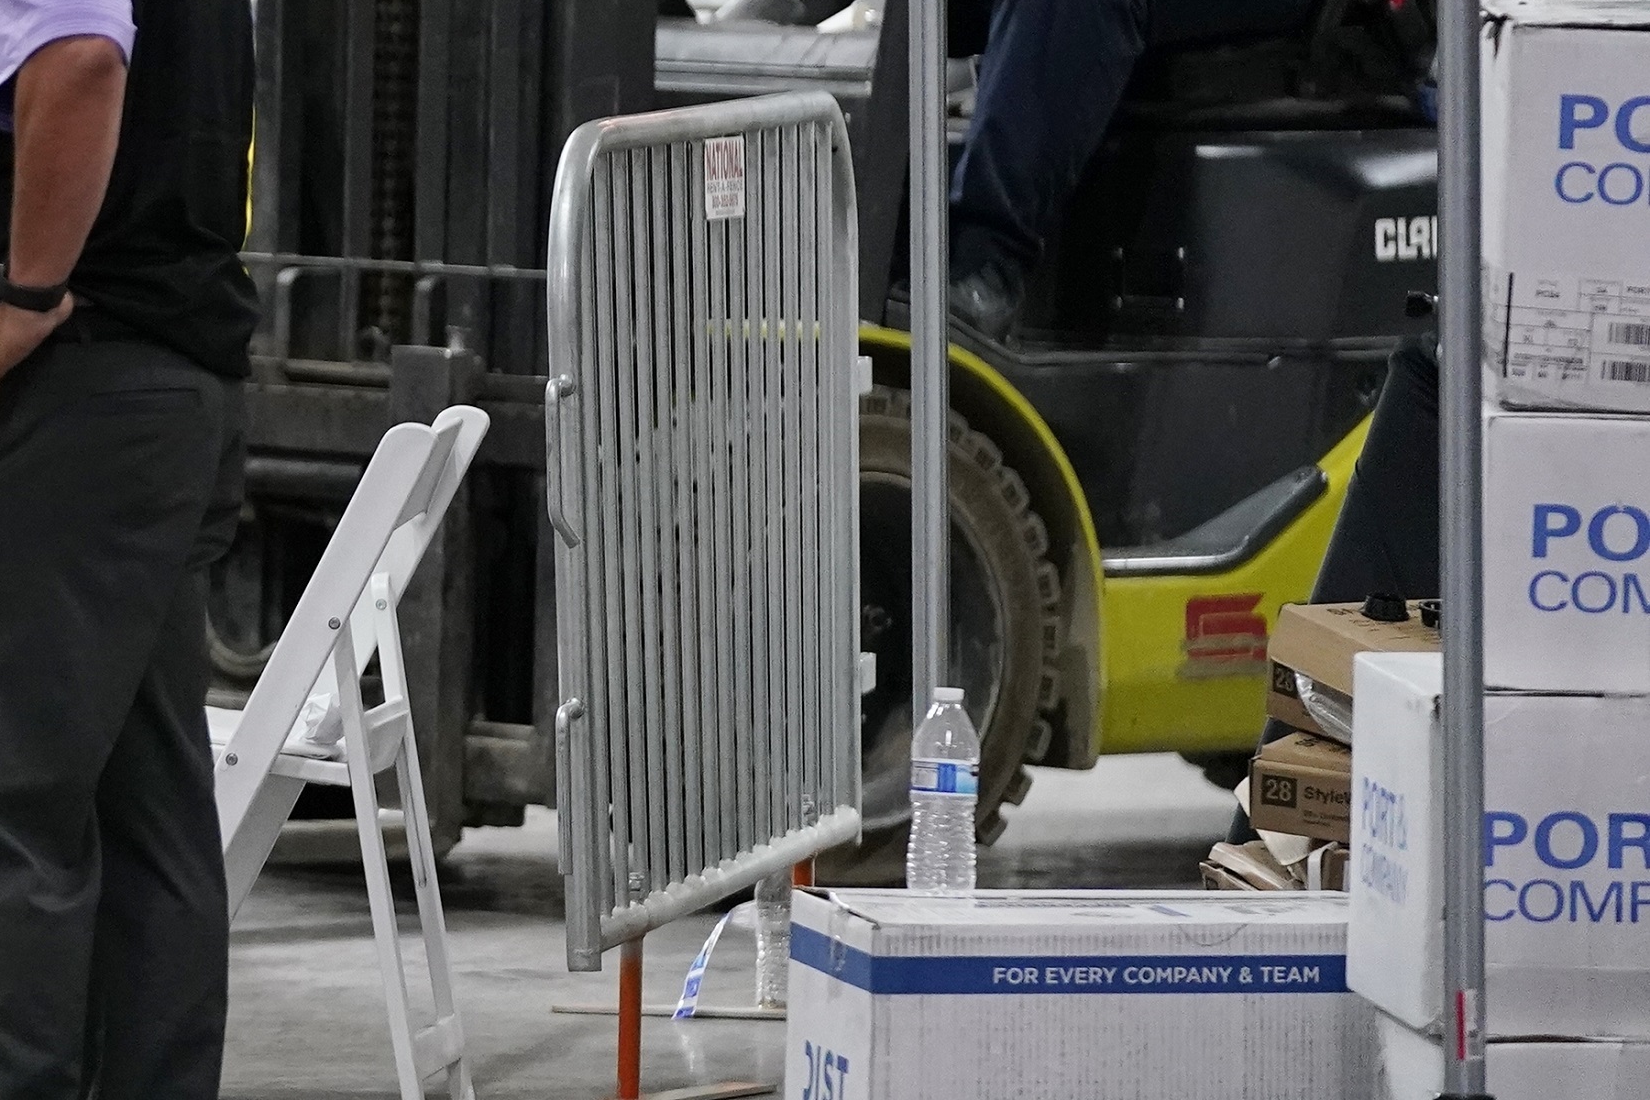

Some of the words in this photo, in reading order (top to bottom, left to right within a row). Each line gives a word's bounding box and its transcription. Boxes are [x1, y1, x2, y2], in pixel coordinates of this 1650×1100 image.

[705, 140, 743, 180] NATIONAL
[1555, 162, 1650, 206] CO
[1266, 778, 1292, 802] 28
[992, 966, 1039, 985] FOR
[1044, 966, 1118, 985] EVERY
[1122, 966, 1233, 984] COMPANY
[1238, 966, 1253, 983] &
[1259, 965, 1320, 983] TEAM
